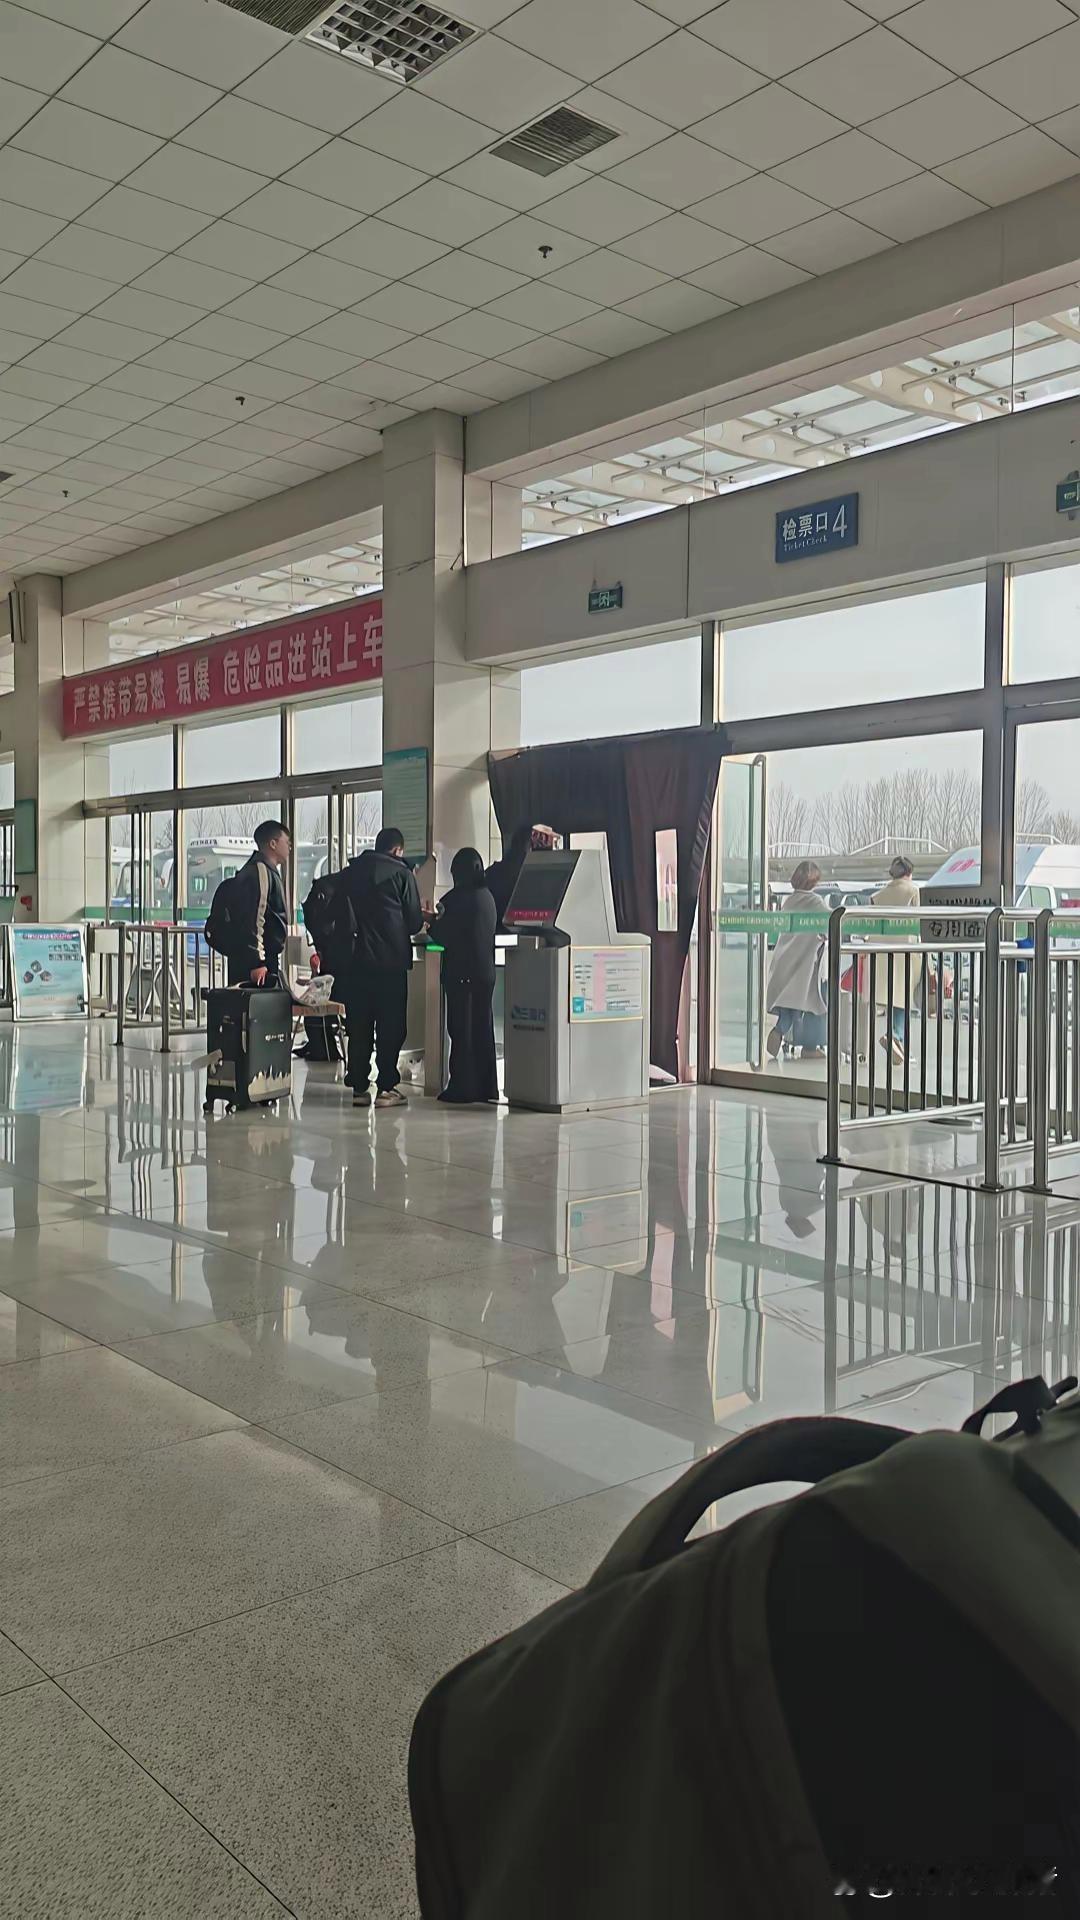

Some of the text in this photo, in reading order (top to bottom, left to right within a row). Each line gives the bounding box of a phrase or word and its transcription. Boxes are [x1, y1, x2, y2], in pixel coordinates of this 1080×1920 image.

[784, 535, 828, 552] Ticket Check
[73, 615, 383, 725] 严禁携带易燃 易爆 危险品进站上车
